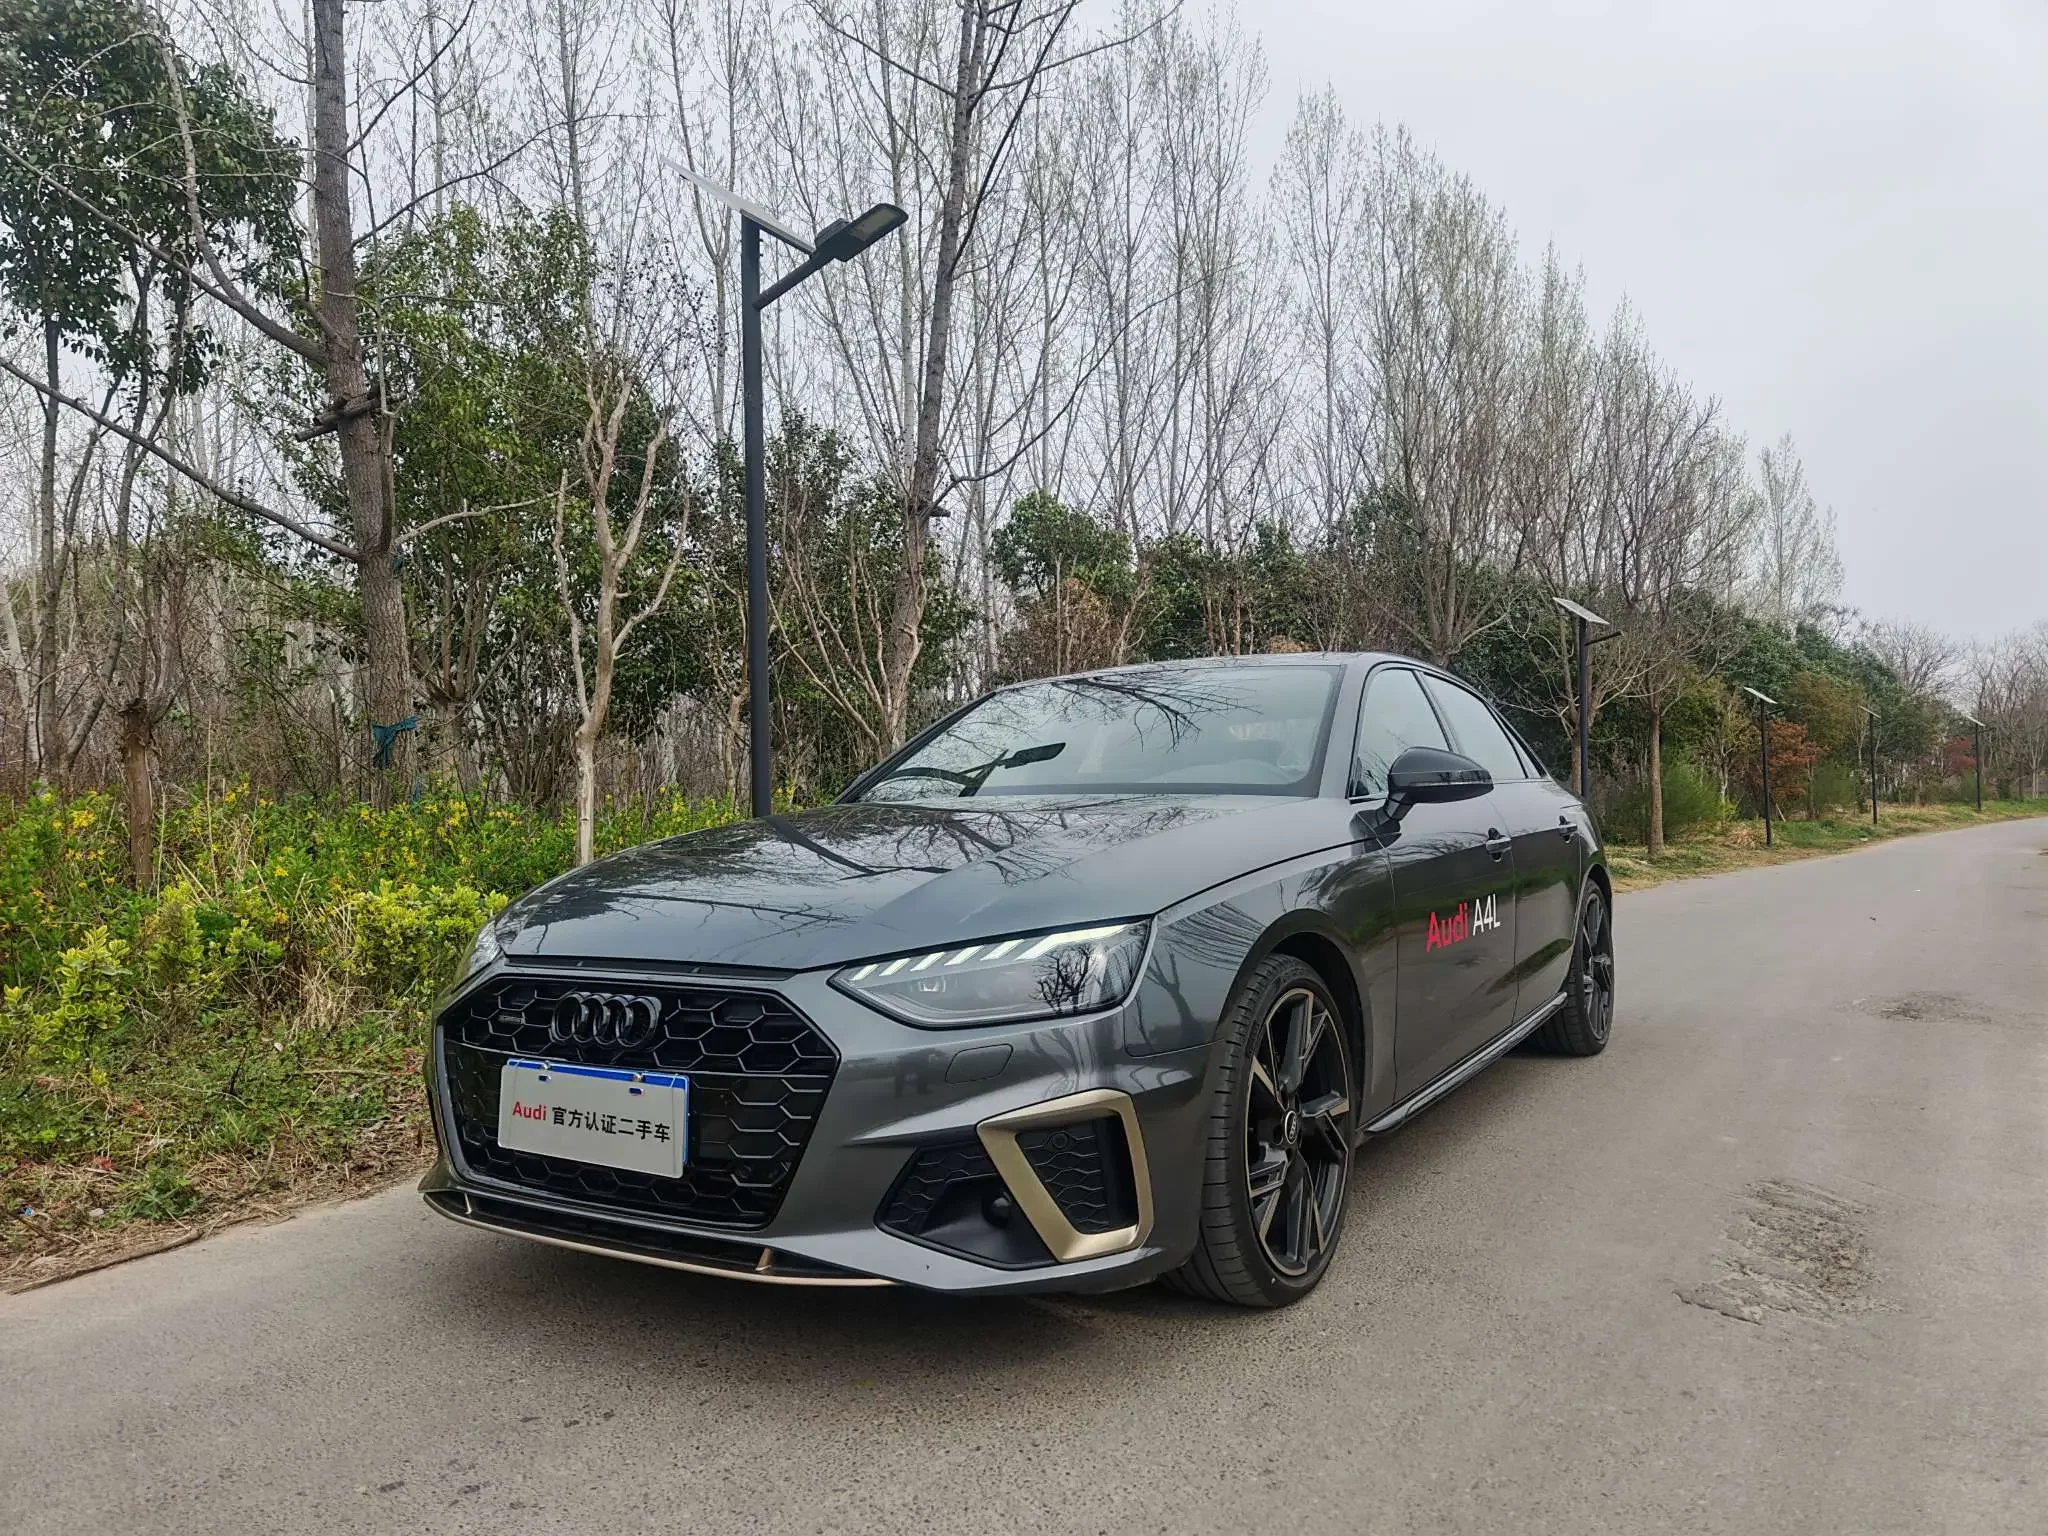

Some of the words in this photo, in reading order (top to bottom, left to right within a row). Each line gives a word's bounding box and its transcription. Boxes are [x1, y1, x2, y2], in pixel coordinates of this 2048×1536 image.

[1425, 902, 1468, 953] Audi
[1472, 893, 1501, 936] A4L
[511, 1100, 547, 1121] Audi
[552, 1105, 671, 1143] 官方认证二手车
